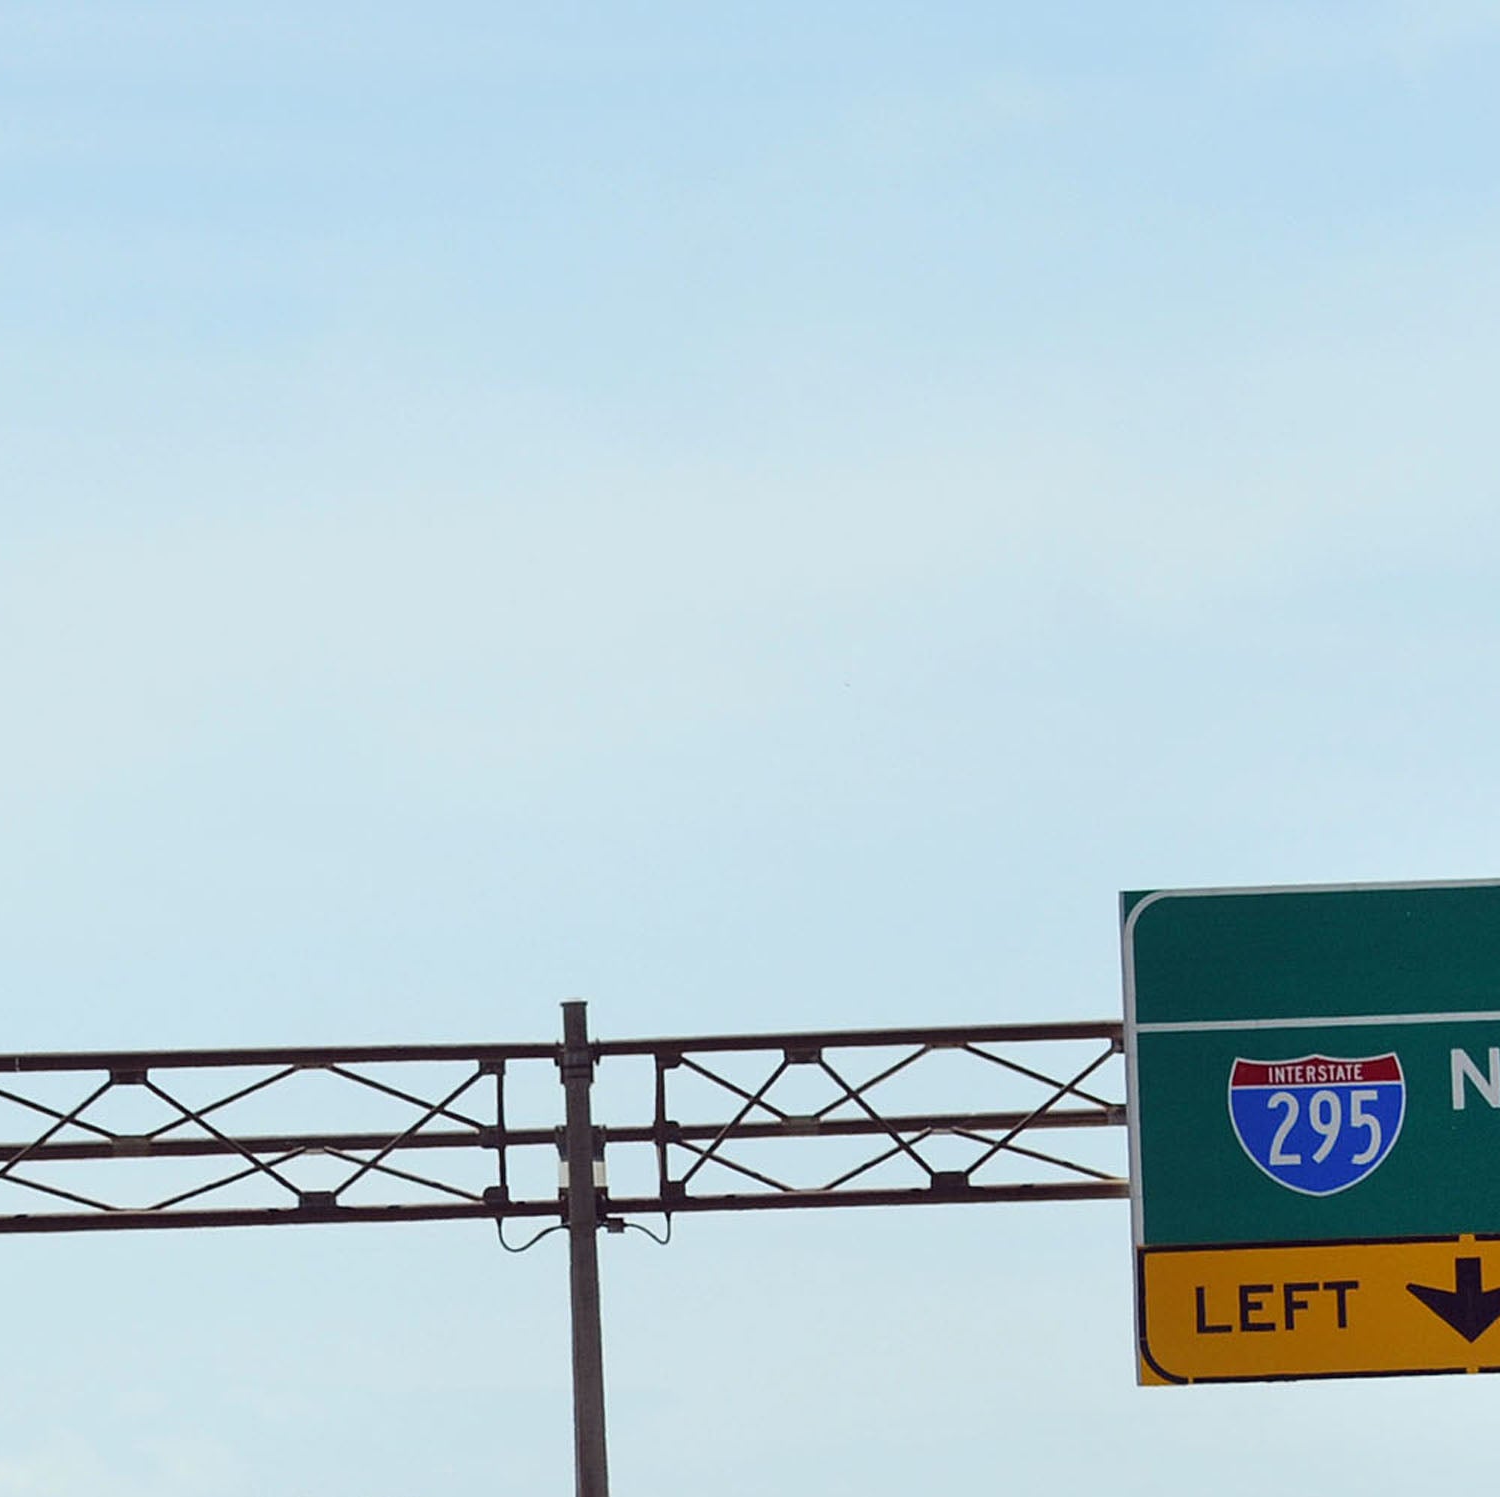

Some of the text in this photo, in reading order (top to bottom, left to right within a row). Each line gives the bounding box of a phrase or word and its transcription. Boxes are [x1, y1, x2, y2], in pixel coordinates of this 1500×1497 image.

[1266, 1060, 1365, 1084] INTERSTATE
[1266, 1089, 1383, 1167] 295
[1195, 1280, 1359, 1334] LEFT
